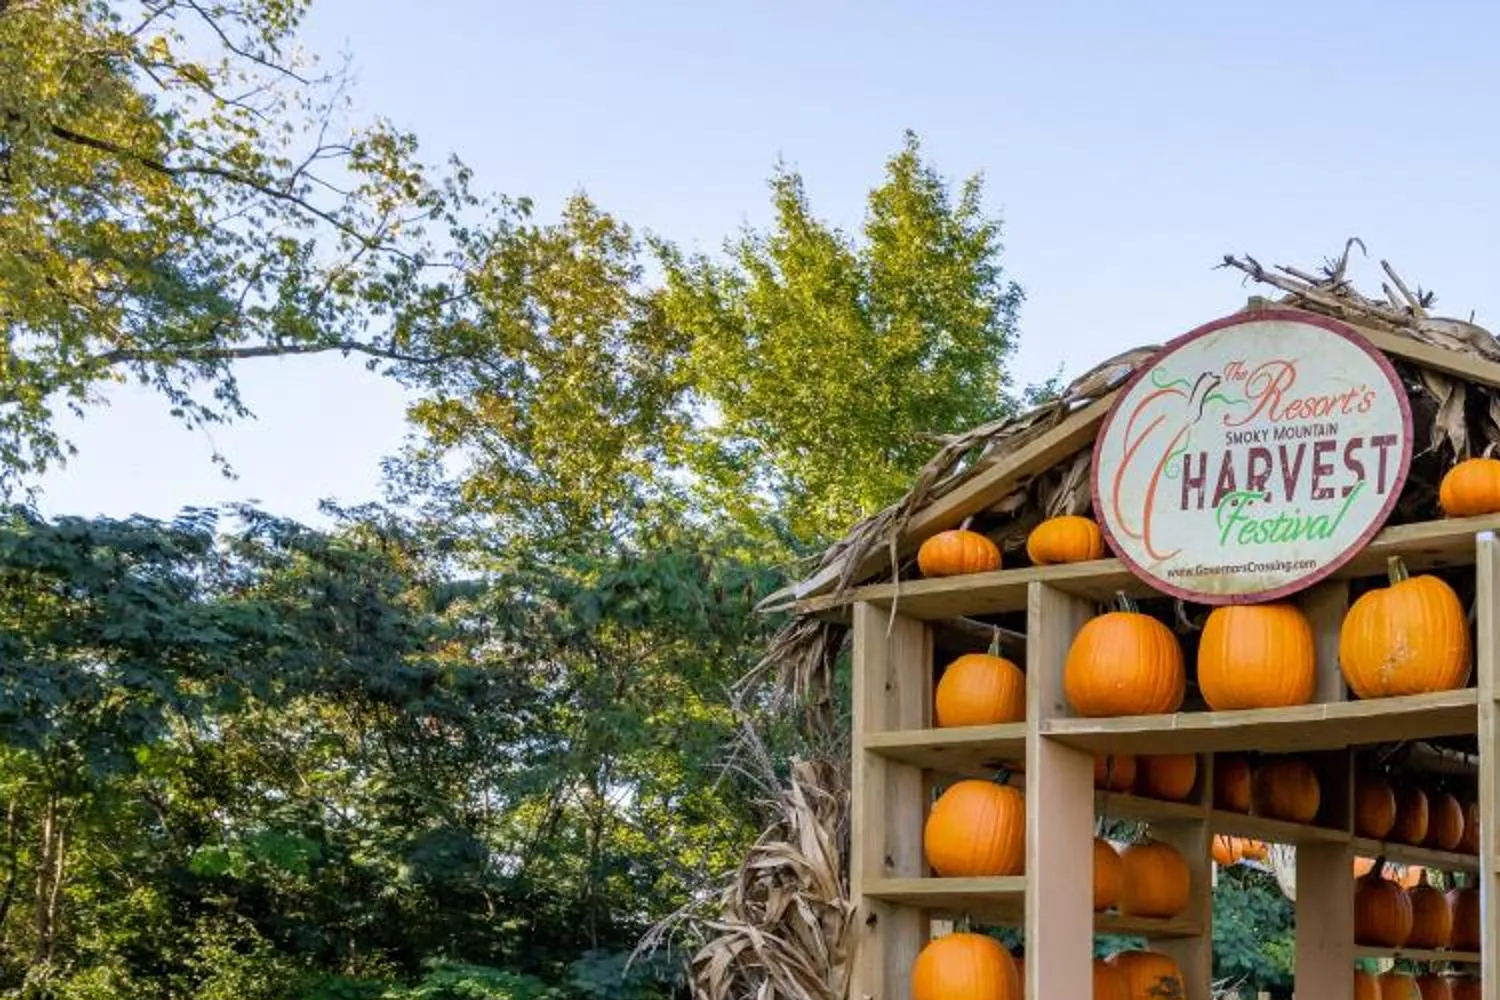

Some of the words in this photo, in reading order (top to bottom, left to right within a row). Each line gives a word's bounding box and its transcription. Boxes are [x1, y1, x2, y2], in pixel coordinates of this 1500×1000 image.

[1223, 360, 1247, 382] The
[1224, 359, 1376, 427] Resort's
[1225, 431, 1269, 446] SMOKY
[1273, 423, 1338, 443] MOUNTAIN
[1181, 434, 1397, 510] HARVEST
[1215, 482, 1368, 546] Festival
